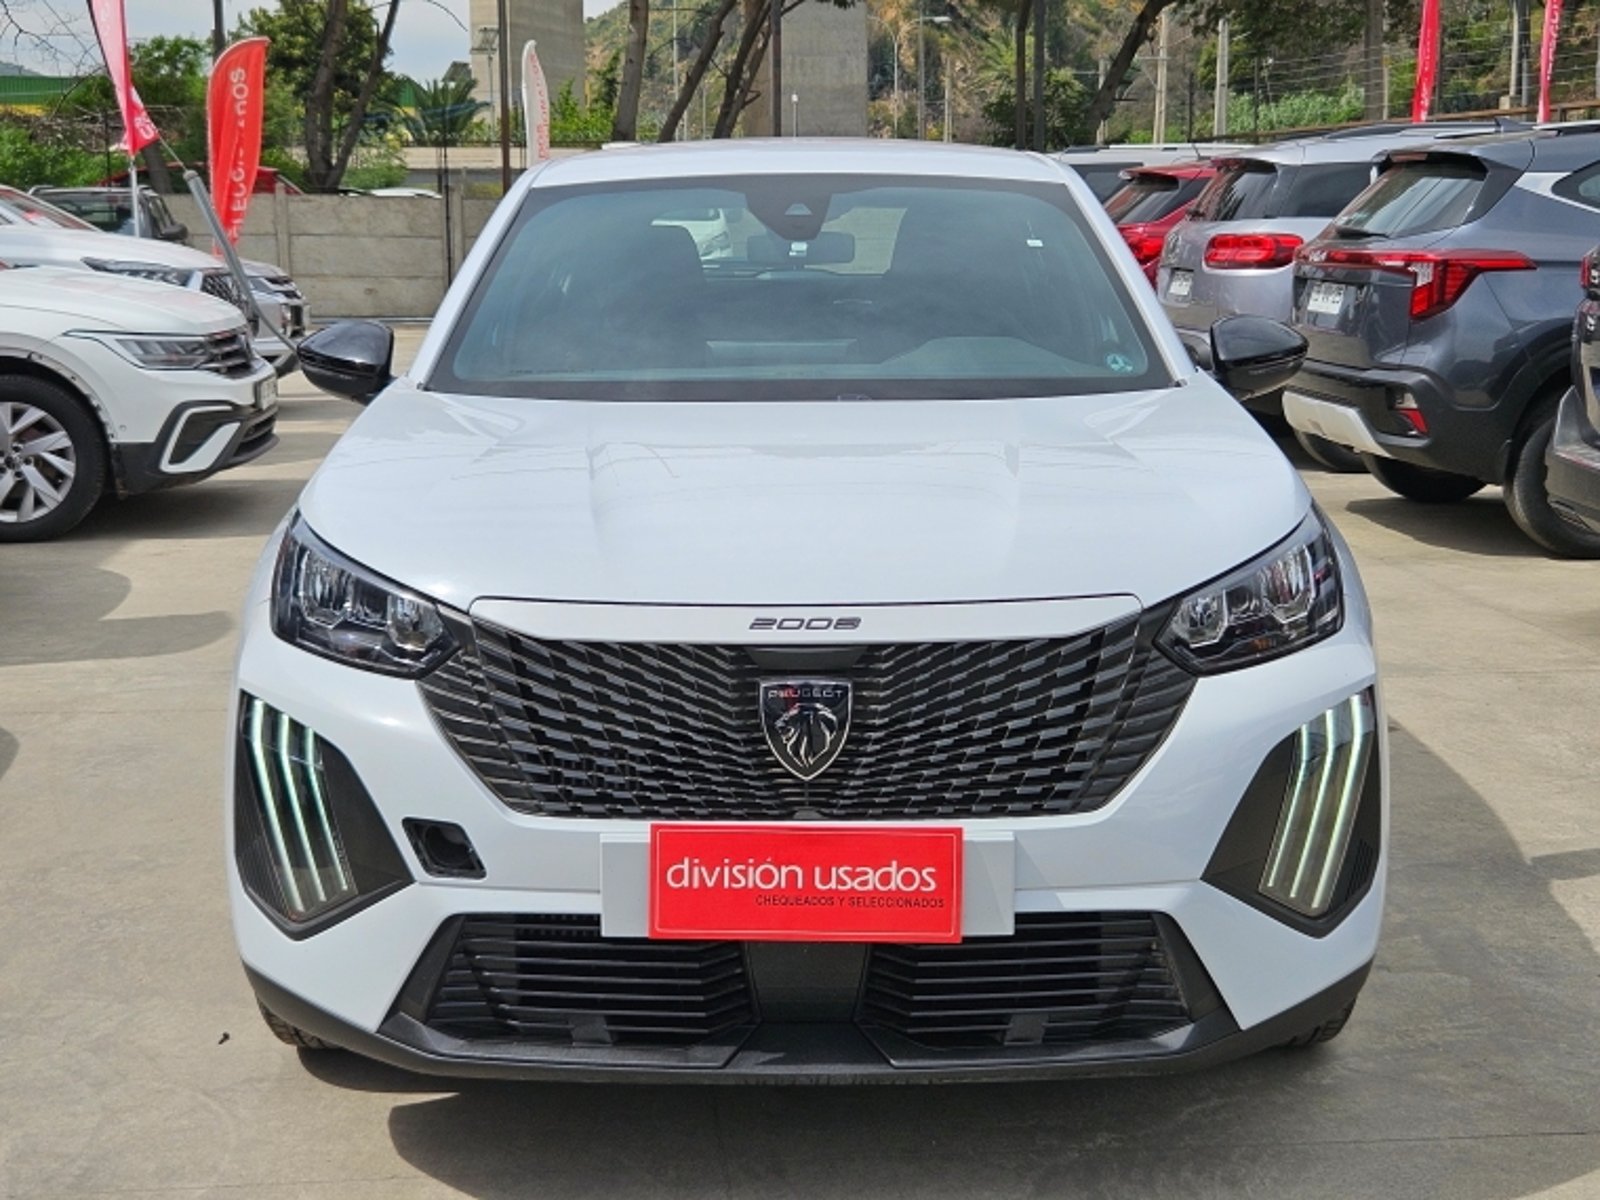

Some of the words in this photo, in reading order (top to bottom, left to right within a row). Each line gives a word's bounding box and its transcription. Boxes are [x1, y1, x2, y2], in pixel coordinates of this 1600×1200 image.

[749, 617, 861, 630] 2008
[767, 688, 843, 699] PEUGEOT
[666, 857, 803, 889] división
[814, 860, 937, 892] usados
[756, 894, 834, 907] CHEQUEADOS
[838, 896, 845, 907] Y
[848, 896, 945, 908] SELECCIONADOS
